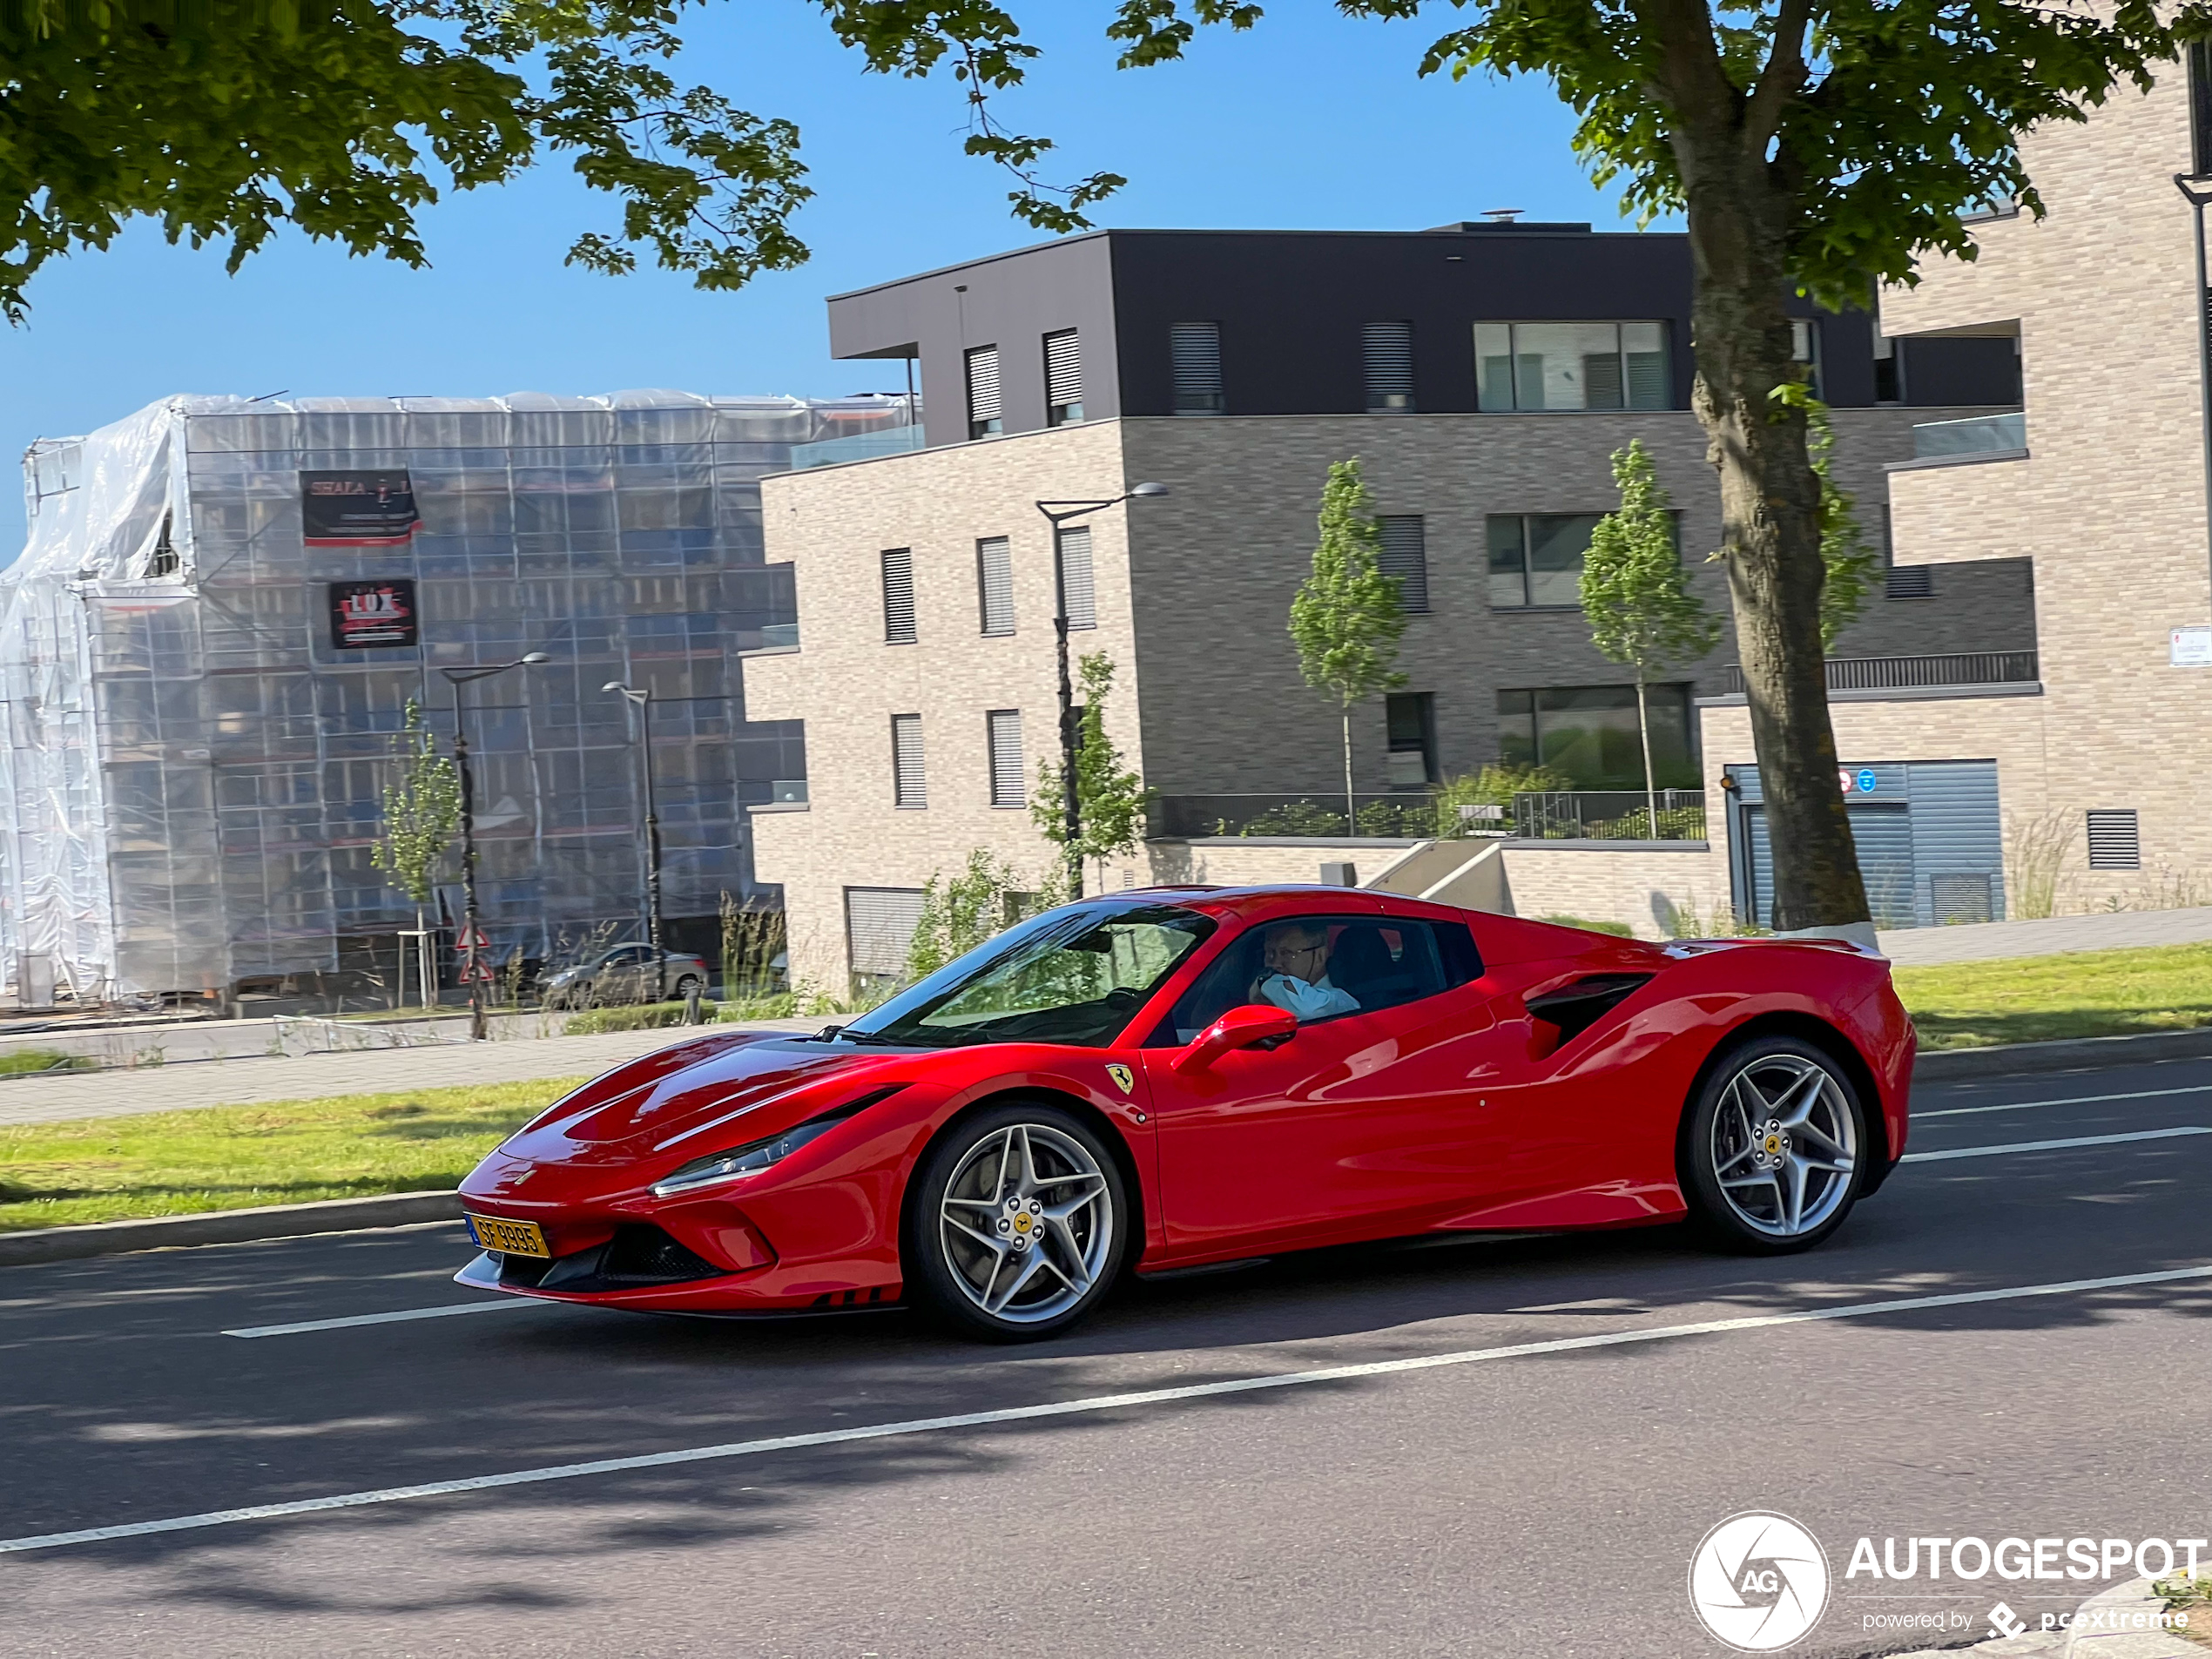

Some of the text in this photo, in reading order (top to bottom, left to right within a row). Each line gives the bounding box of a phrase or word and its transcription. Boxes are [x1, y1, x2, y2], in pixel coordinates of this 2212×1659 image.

[351, 594, 395, 611] LUX
[478, 1219, 538, 1252] SF 9995
